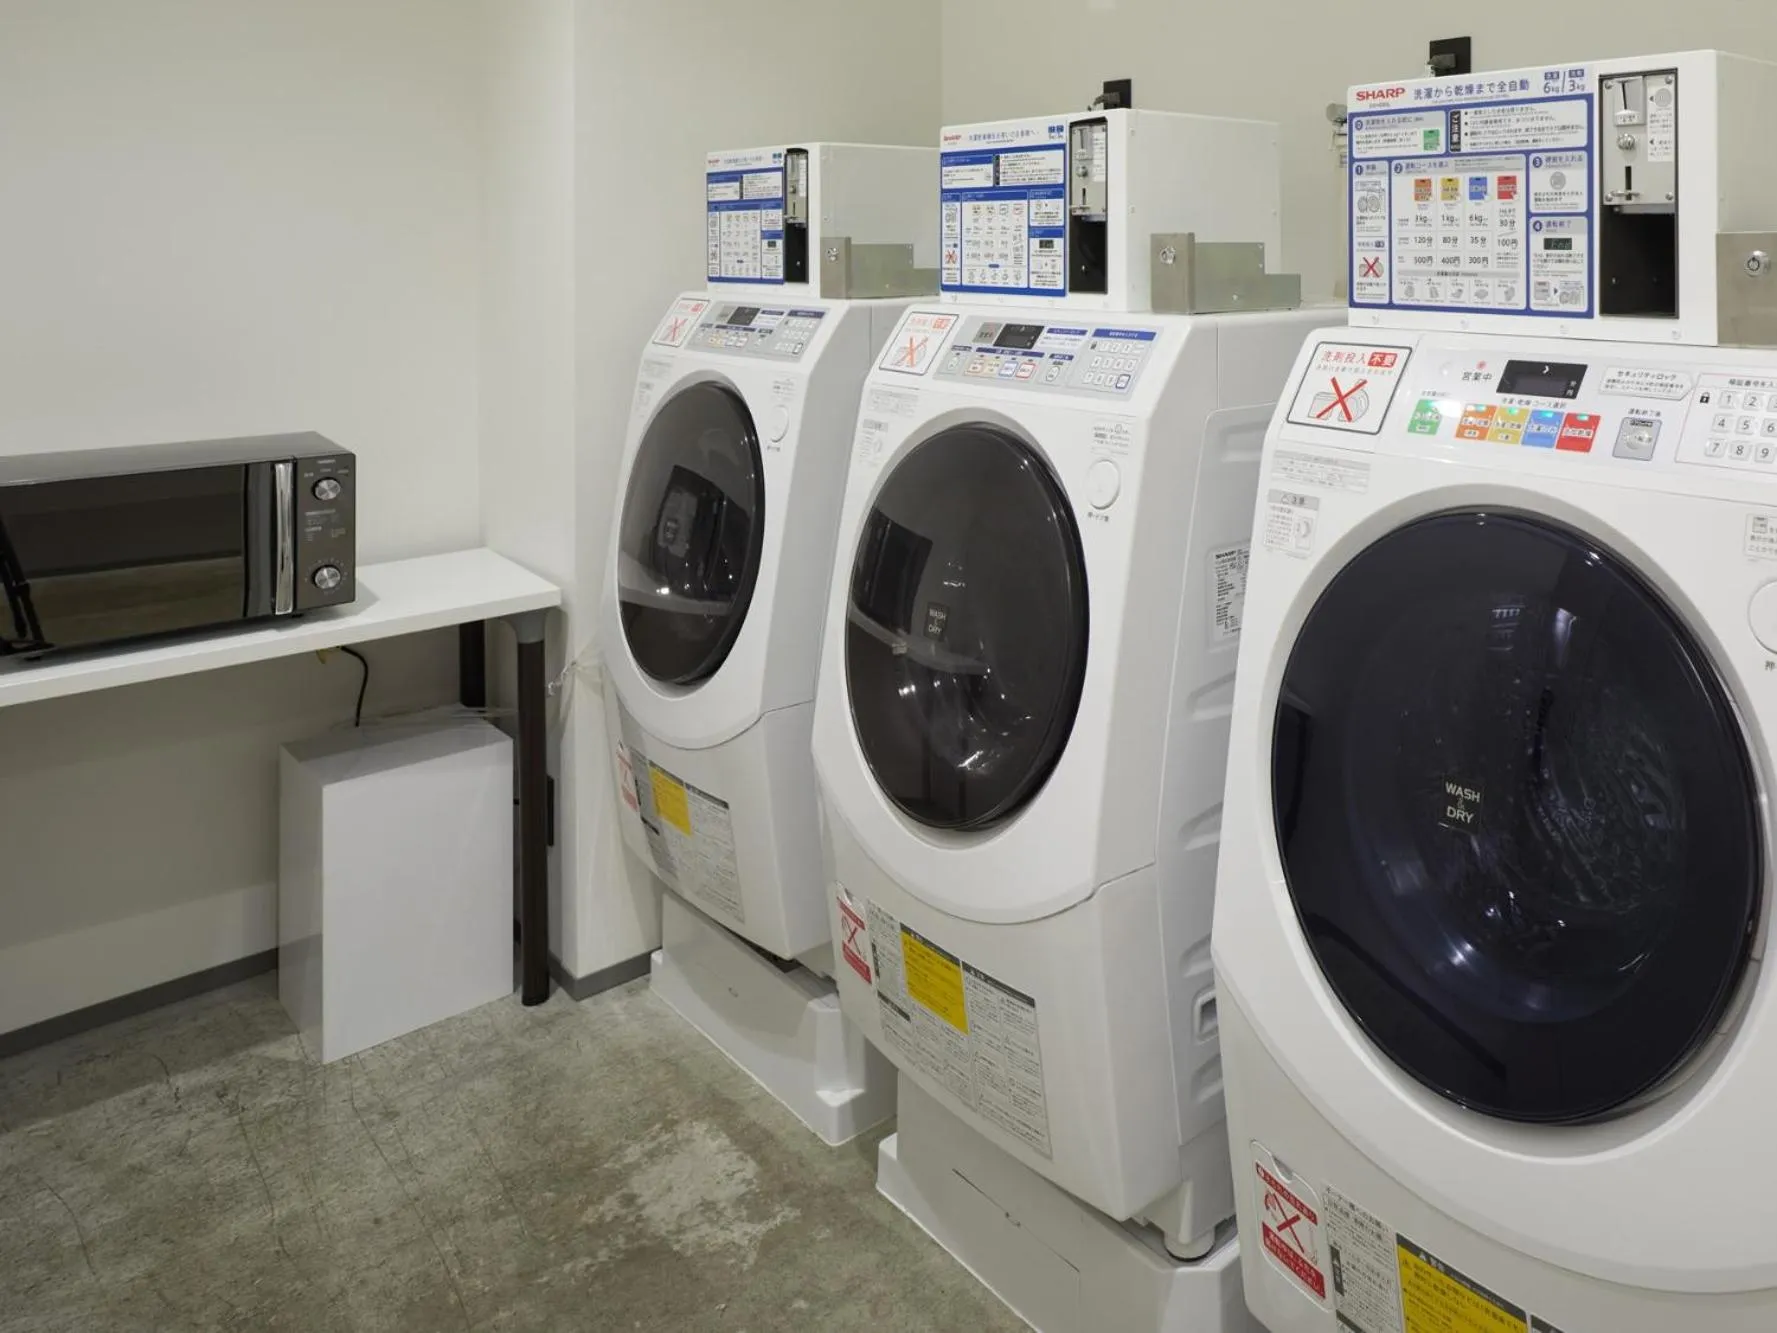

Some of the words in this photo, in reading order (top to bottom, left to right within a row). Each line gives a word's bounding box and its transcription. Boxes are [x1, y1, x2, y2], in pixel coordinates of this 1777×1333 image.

[1356, 87, 1406, 101] SHARP
[1413, 79, 1530, 101] 洗濯から乾燥まで全自動
[1497, 238, 1519, 247] 100円
[1468, 256, 1489, 264] 300円
[1321, 351, 1366, 365] 洗剤投入
[1369, 352, 1397, 367] 不要
[1461, 371, 1493, 382] 営業中
[1617, 370, 1677, 380] セキュリティロック
[1725, 395, 1732, 404] 1
[1748, 396, 1757, 407] 2
[1717, 418, 1726, 428] 4
[1742, 420, 1750, 430] 5
[1767, 423, 1775, 433] 6
[1712, 442, 1721, 452] 7
[1736, 445, 1745, 456] 8
[1761, 447, 1770, 459] 9
[1444, 781, 1481, 804] WASH
[1446, 805, 1475, 825] DRY
